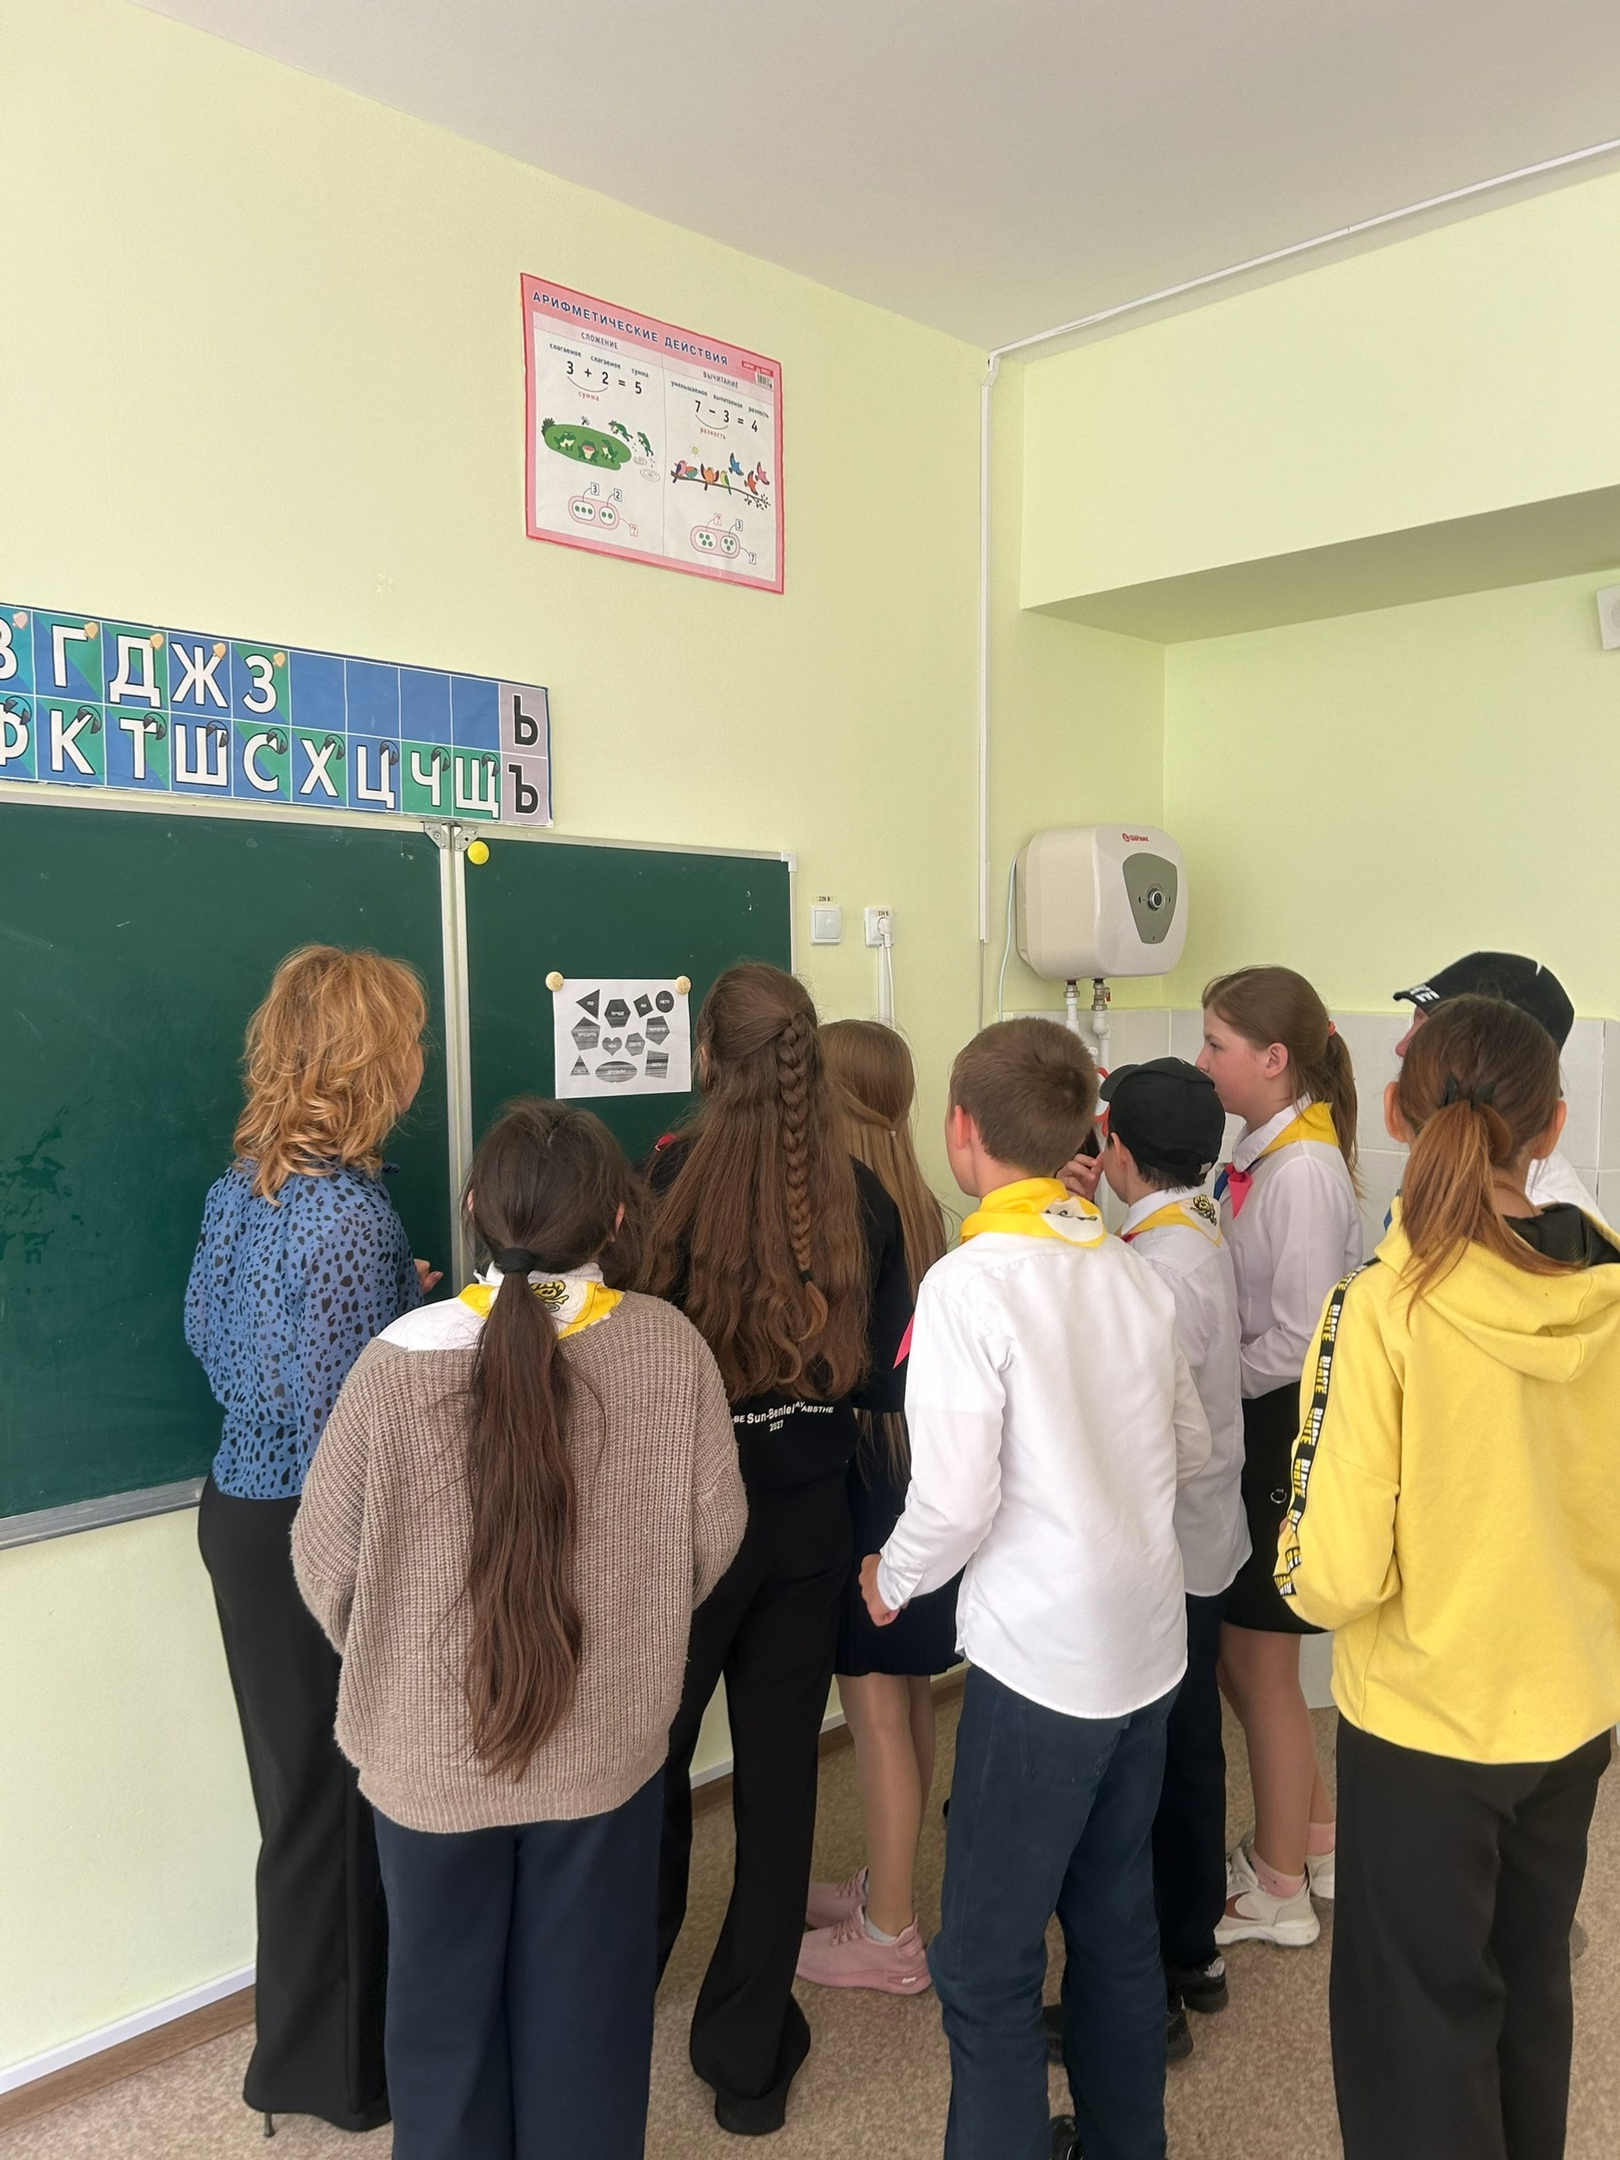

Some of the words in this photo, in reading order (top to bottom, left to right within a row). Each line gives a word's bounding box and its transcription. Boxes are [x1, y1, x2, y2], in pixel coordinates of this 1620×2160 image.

[533, 291, 658, 342] АРИФМЕТИЧЕСКИЕ
[664, 336, 728, 366] ДЕЙСТВИЯ
[581, 332, 618, 350] СЛОЖЕНИЕ
[549, 342, 582, 358] слагаемое
[590, 355, 621, 370] слагаемое
[631, 368, 649, 378] сумма
[566, 361, 574, 375] 3
[584, 368, 592, 378] +
[601, 371, 609, 385] 2
[618, 379, 626, 387] =
[635, 381, 642, 394] 5
[703, 371, 739, 389] ВЫЧИТАНИЕ
[578, 391, 600, 402] сумма
[695, 400, 701, 413] 7
[723, 410, 730, 423] 3
[751, 420, 758, 433] 4
[51, 624, 90, 687] Г
[108, 634, 162, 708] Д
[170, 642, 229, 709] Ж
[50, 709, 97, 775] К
[118, 716, 159, 779] Т
[174, 724, 229, 787] Ш
[242, 732, 281, 792] С
[300, 738, 339, 797] Х
[356, 745, 396, 809] Ц
[410, 750, 441, 807] Ч
[454, 756, 499, 819] Щ
[507, 762, 540, 815] Ъ
